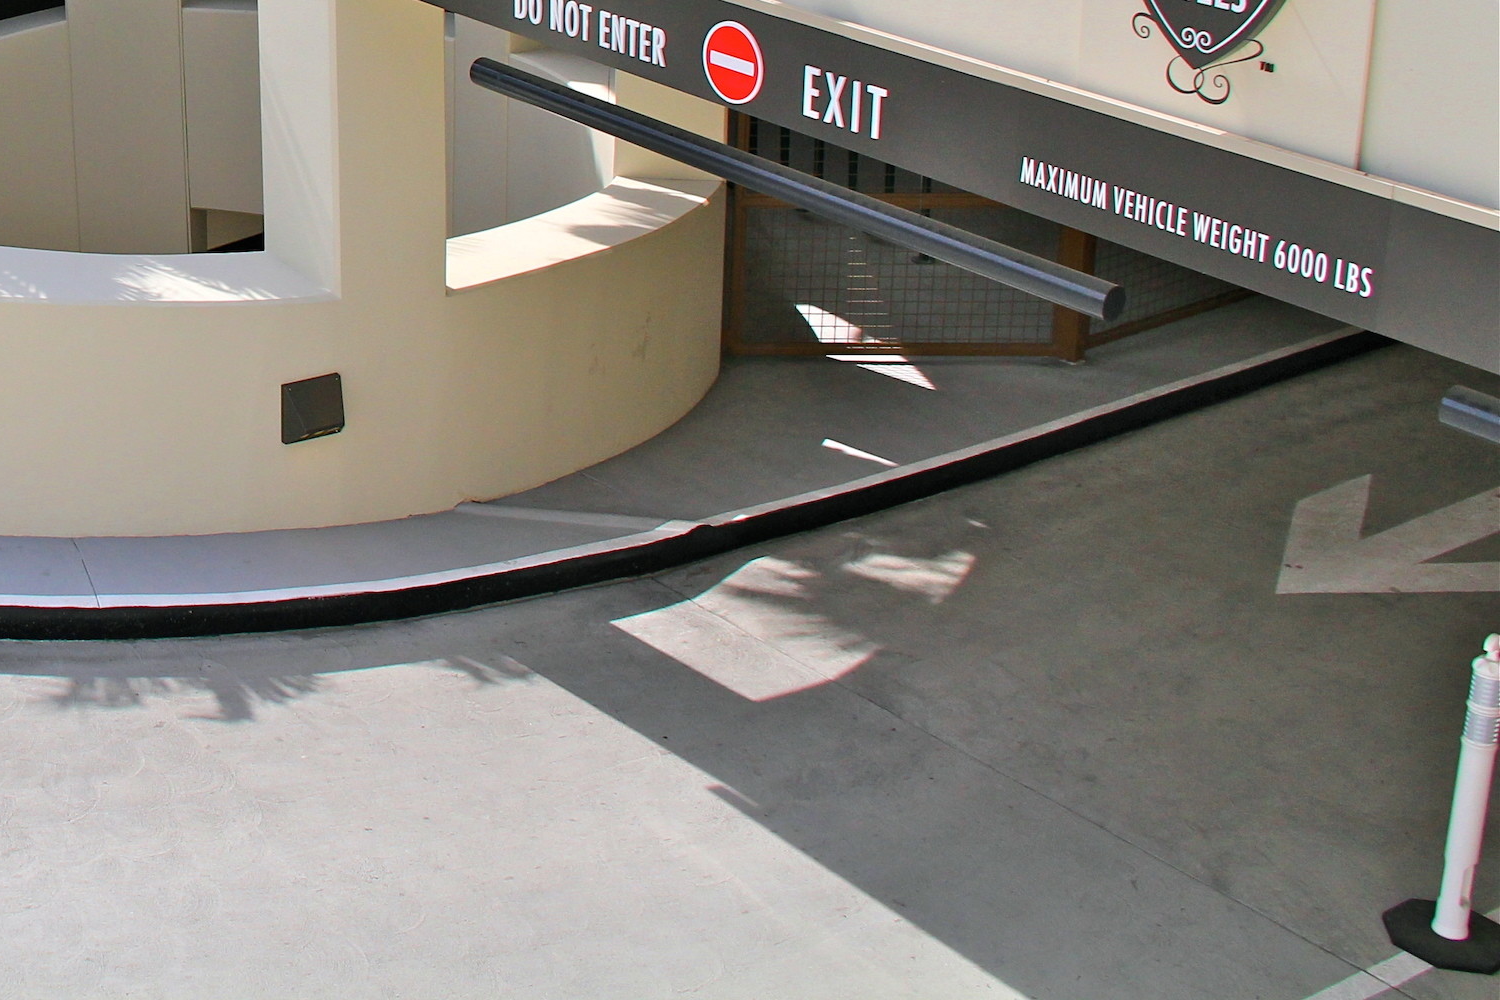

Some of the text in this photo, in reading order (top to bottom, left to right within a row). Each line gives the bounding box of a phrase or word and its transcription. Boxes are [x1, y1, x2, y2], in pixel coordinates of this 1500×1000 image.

[599, 10, 667, 68] ENTER
[802, 64, 889, 140] EXIT
[1020, 156, 1374, 298] MAXIMUM VEHICLE WEIGHT 6000 LBS
